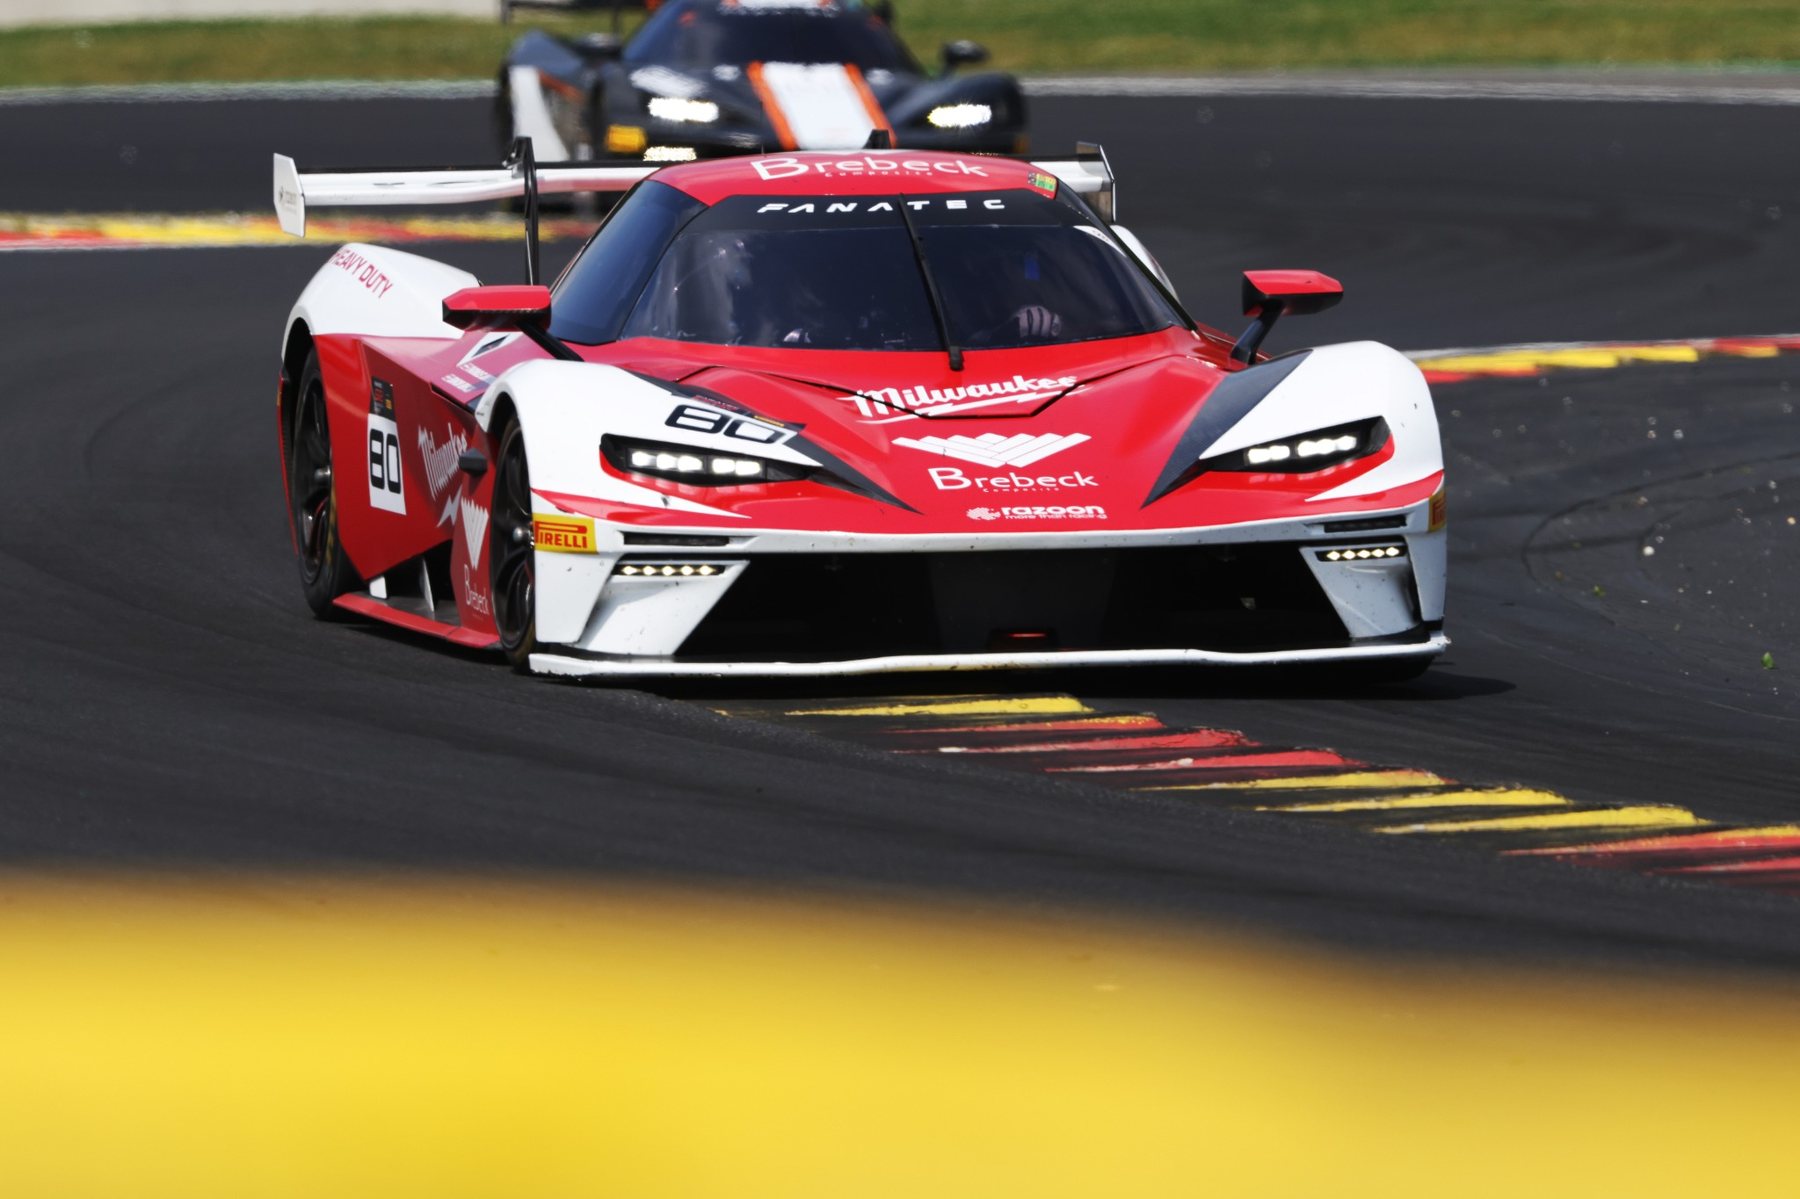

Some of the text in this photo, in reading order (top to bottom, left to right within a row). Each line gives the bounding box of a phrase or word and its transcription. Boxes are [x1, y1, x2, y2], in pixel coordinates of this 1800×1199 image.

[750, 156, 989, 181] Brebeck
[757, 199, 1006, 214] FANATEC
[328, 249, 394, 299] HEAVY DUTY
[838, 375, 1079, 418] Milwaukee
[664, 404, 787, 445] 80
[369, 428, 402, 495] 80
[417, 421, 468, 502] Milwaukee
[927, 467, 1100, 491] Brebeck
[1000, 505, 1106, 516] razoon
[534, 520, 588, 549] PIRELLI
